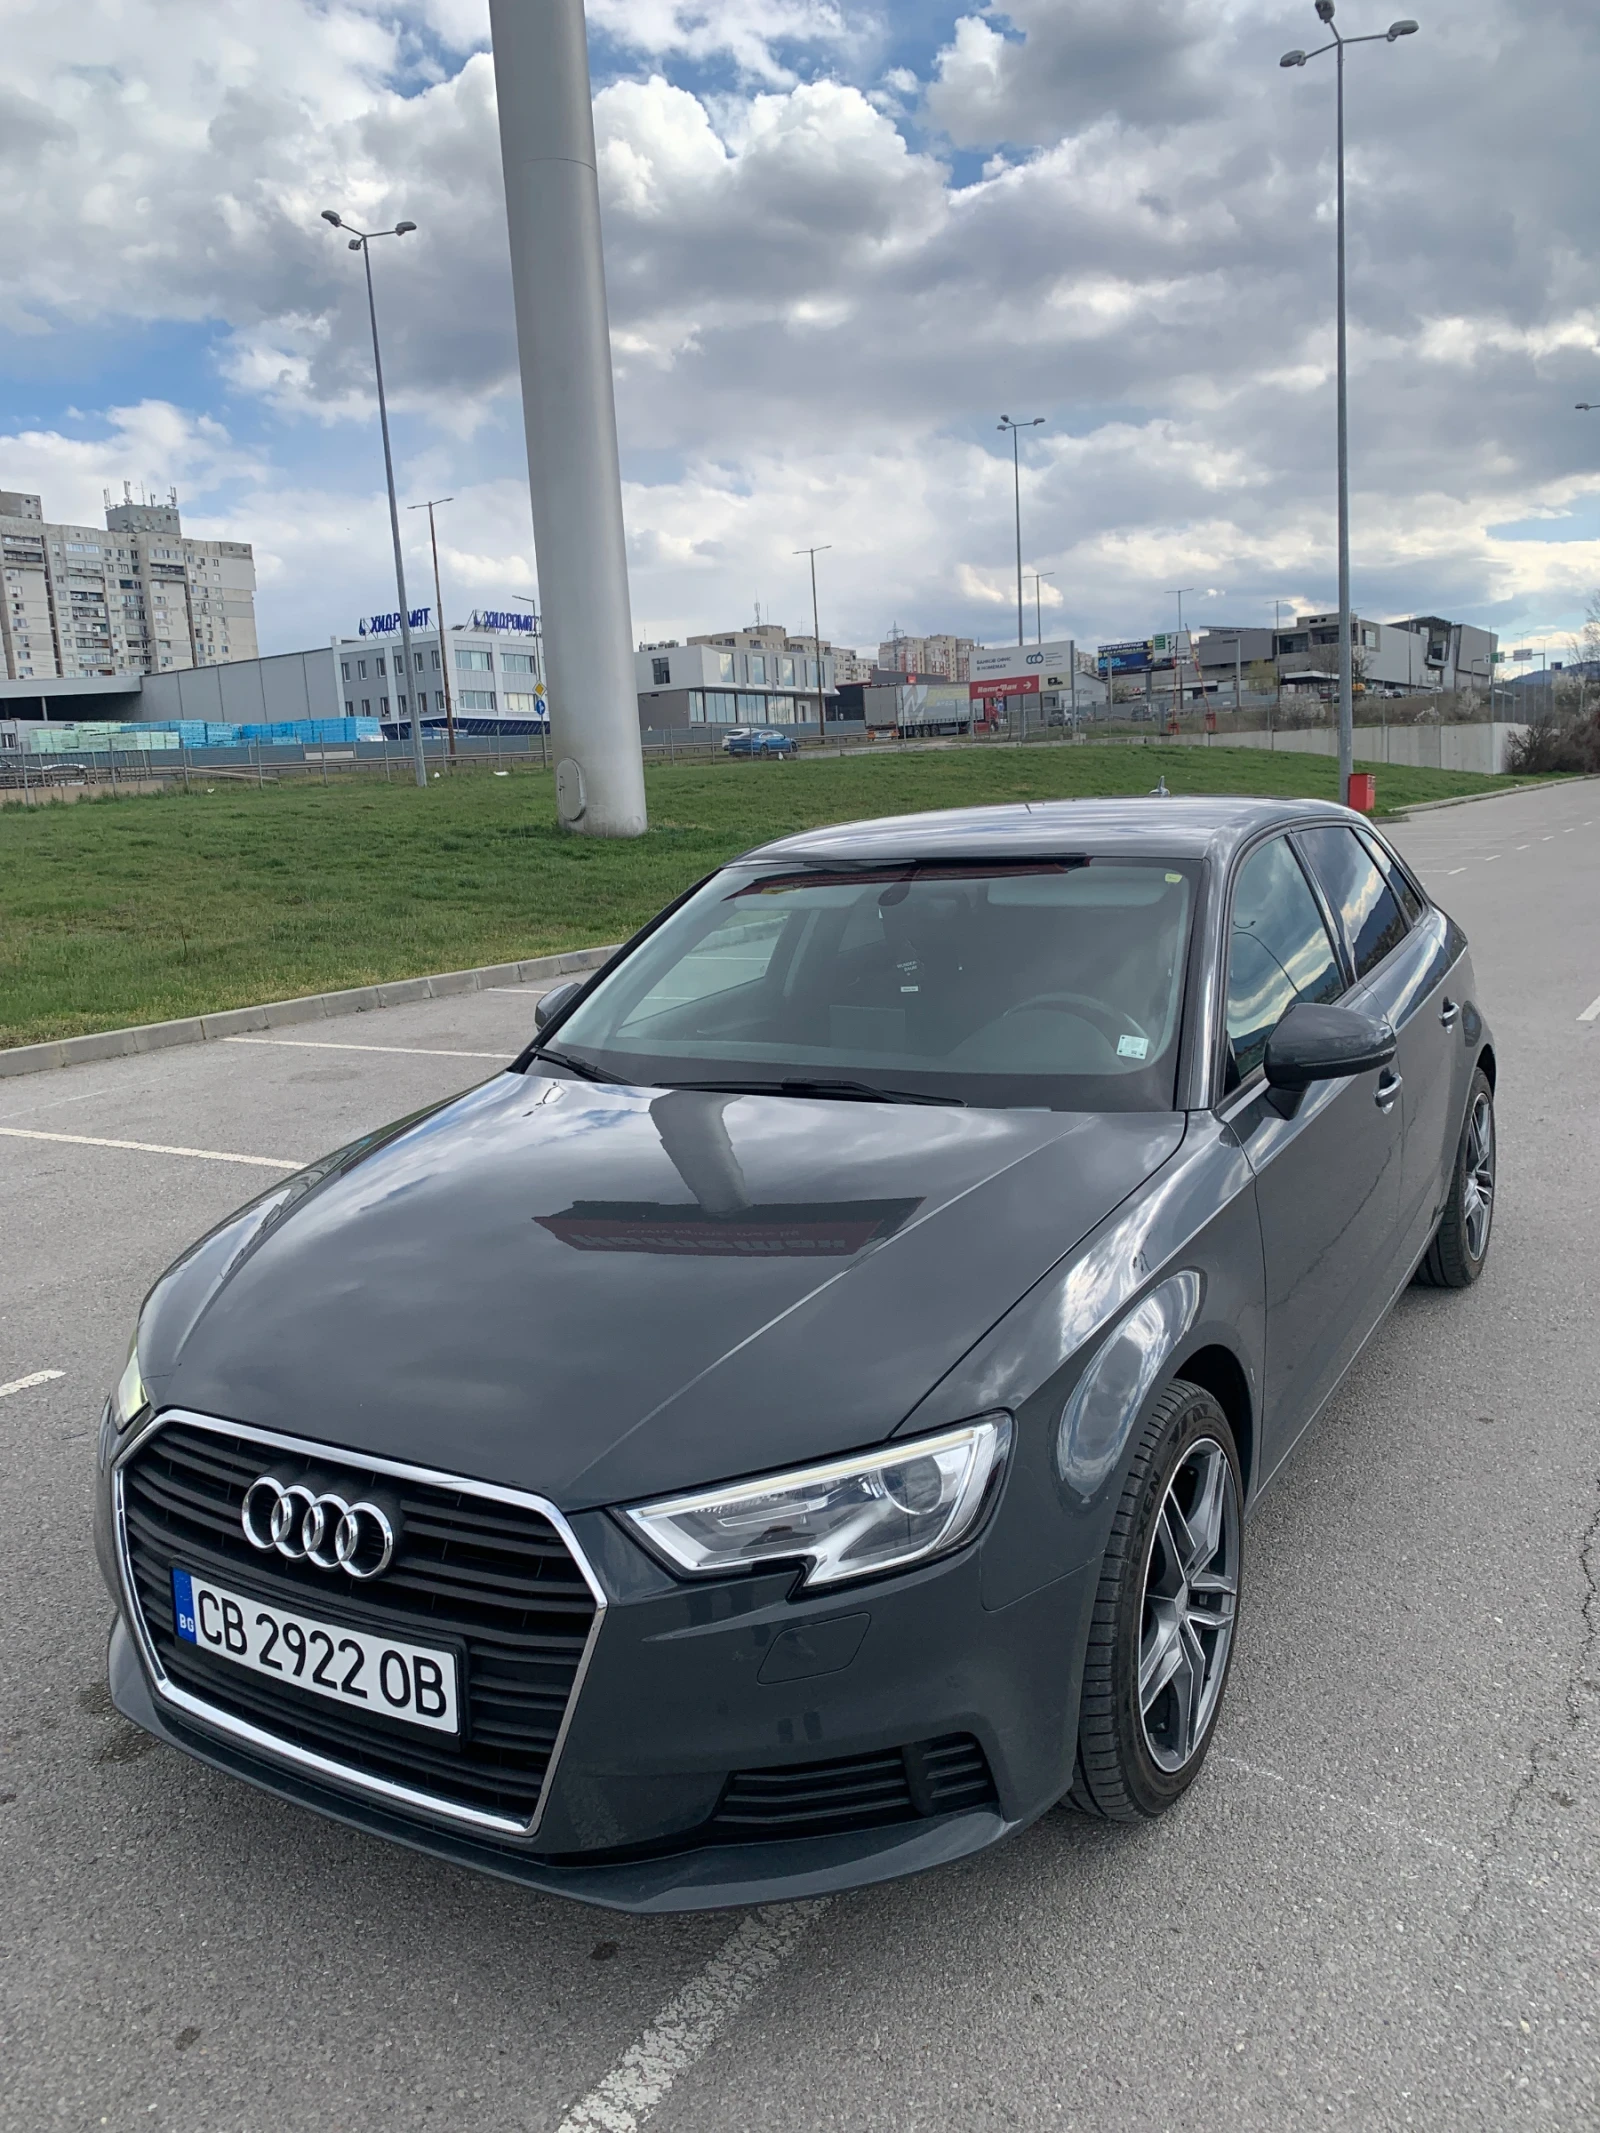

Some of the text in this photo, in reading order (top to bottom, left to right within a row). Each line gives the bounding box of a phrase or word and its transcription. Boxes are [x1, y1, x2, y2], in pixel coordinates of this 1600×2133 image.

[370, 607, 431, 633] ХИДРМАТ
[179, 1613, 195, 1634] BG
[197, 1589, 447, 1719] CB 2922 OB
